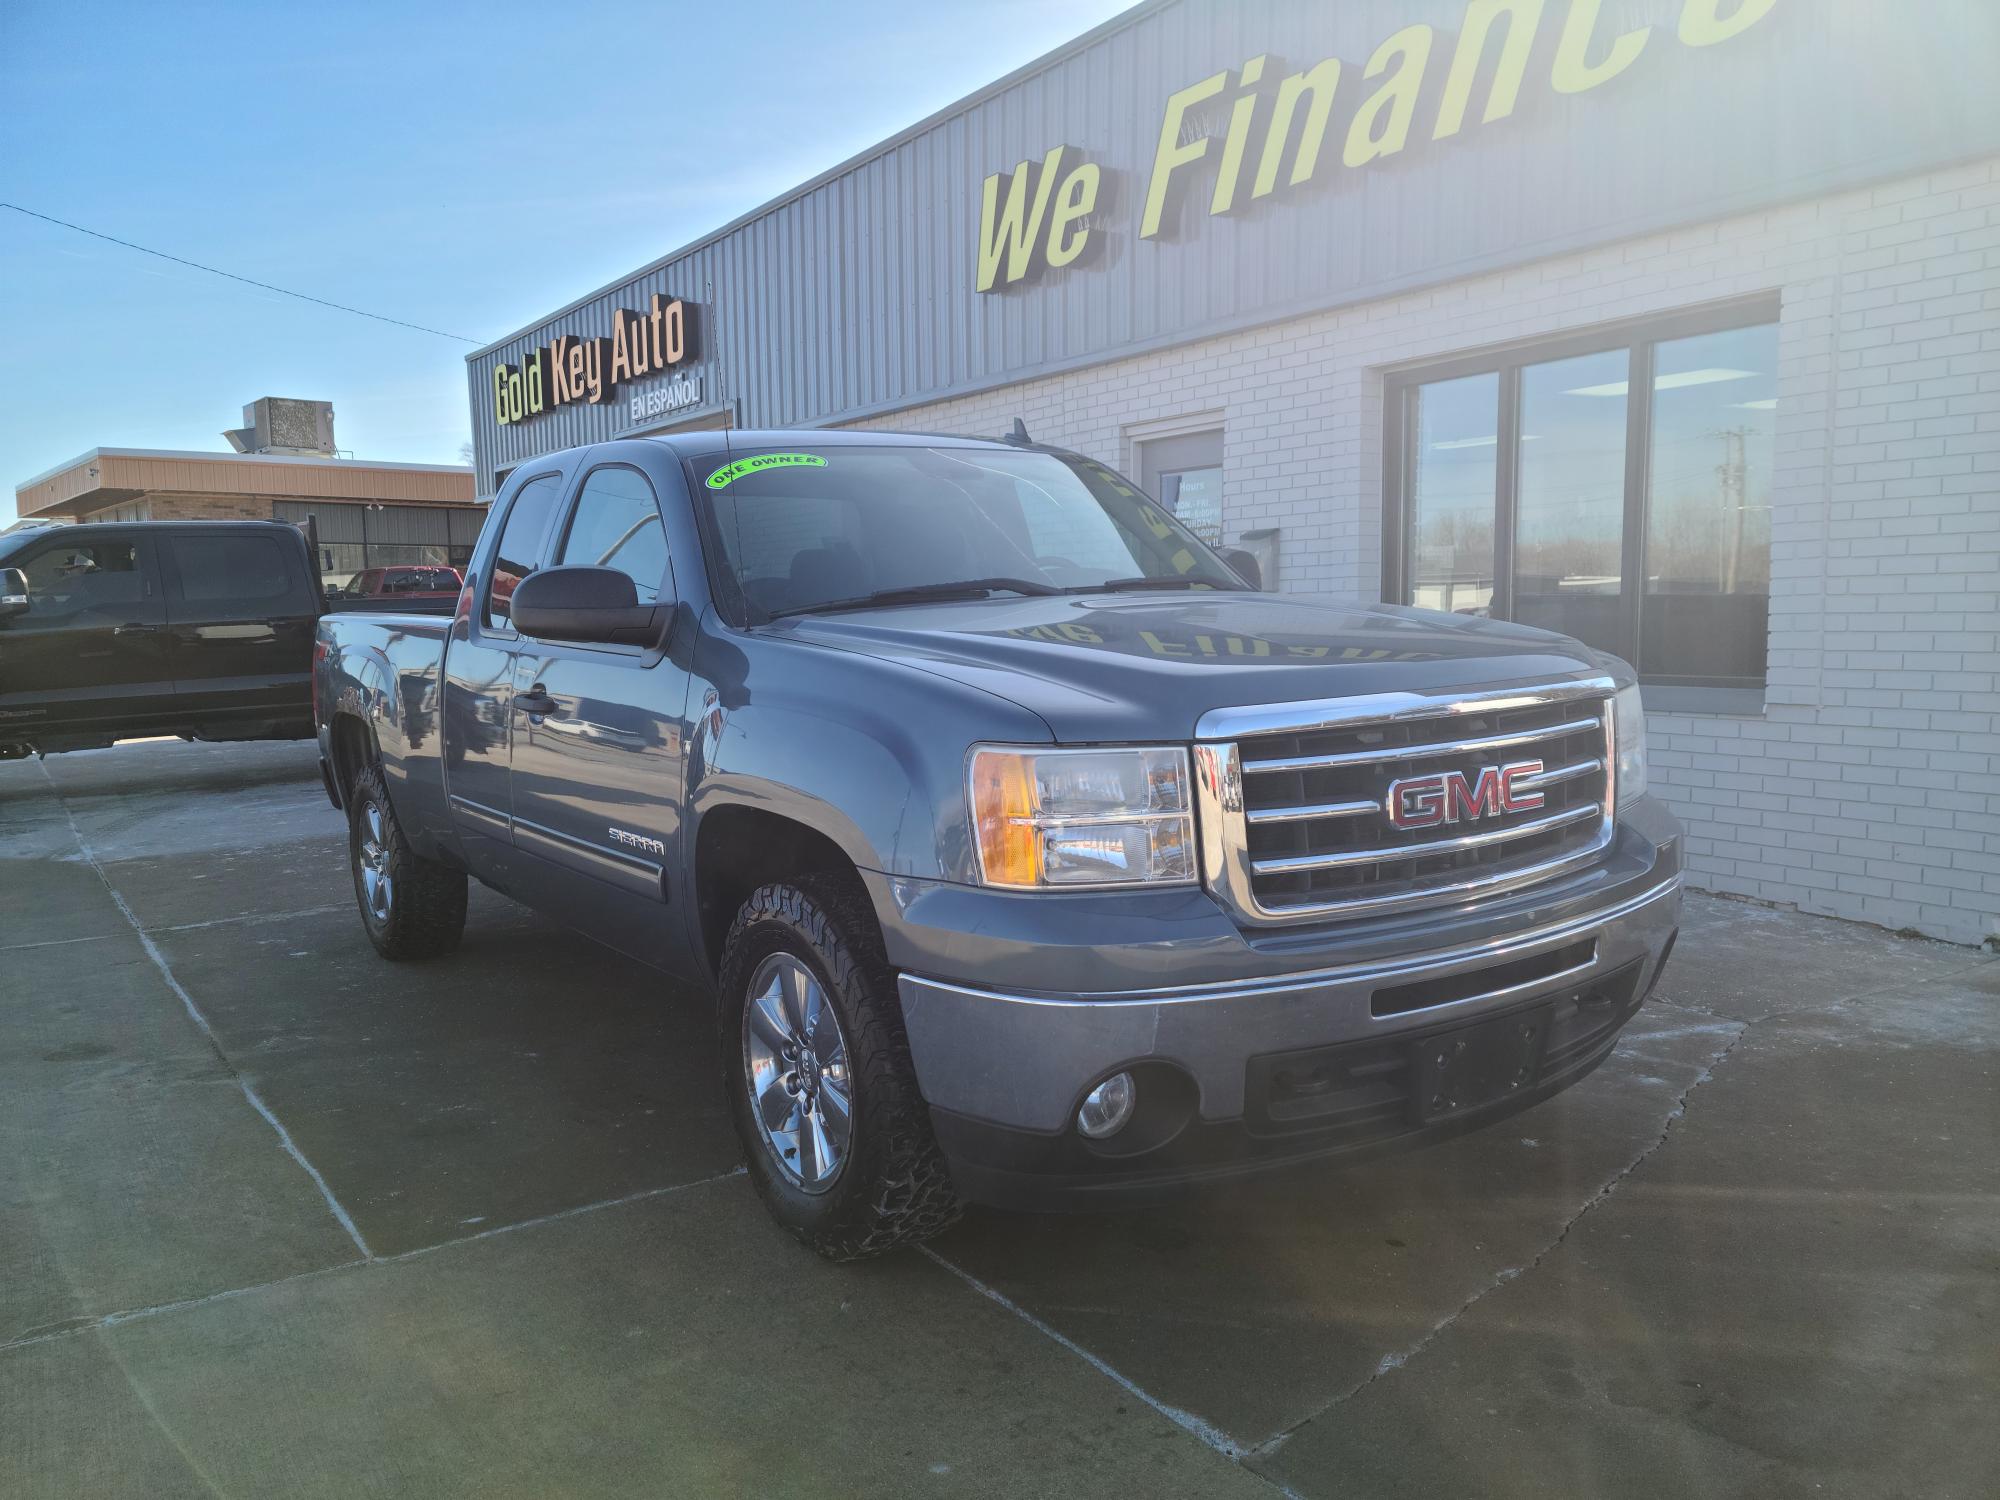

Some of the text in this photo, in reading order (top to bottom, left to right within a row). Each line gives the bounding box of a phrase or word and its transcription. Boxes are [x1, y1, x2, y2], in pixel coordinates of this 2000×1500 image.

[976, 0, 1777, 293] We Financ
[494, 292, 684, 426] Gold Key Auto
[632, 374, 701, 420] EN ESPAÑOL
[714, 456, 818, 484] ONE OWNER
[1388, 759, 1545, 831] GMC
[608, 827, 665, 856] SIERRA
